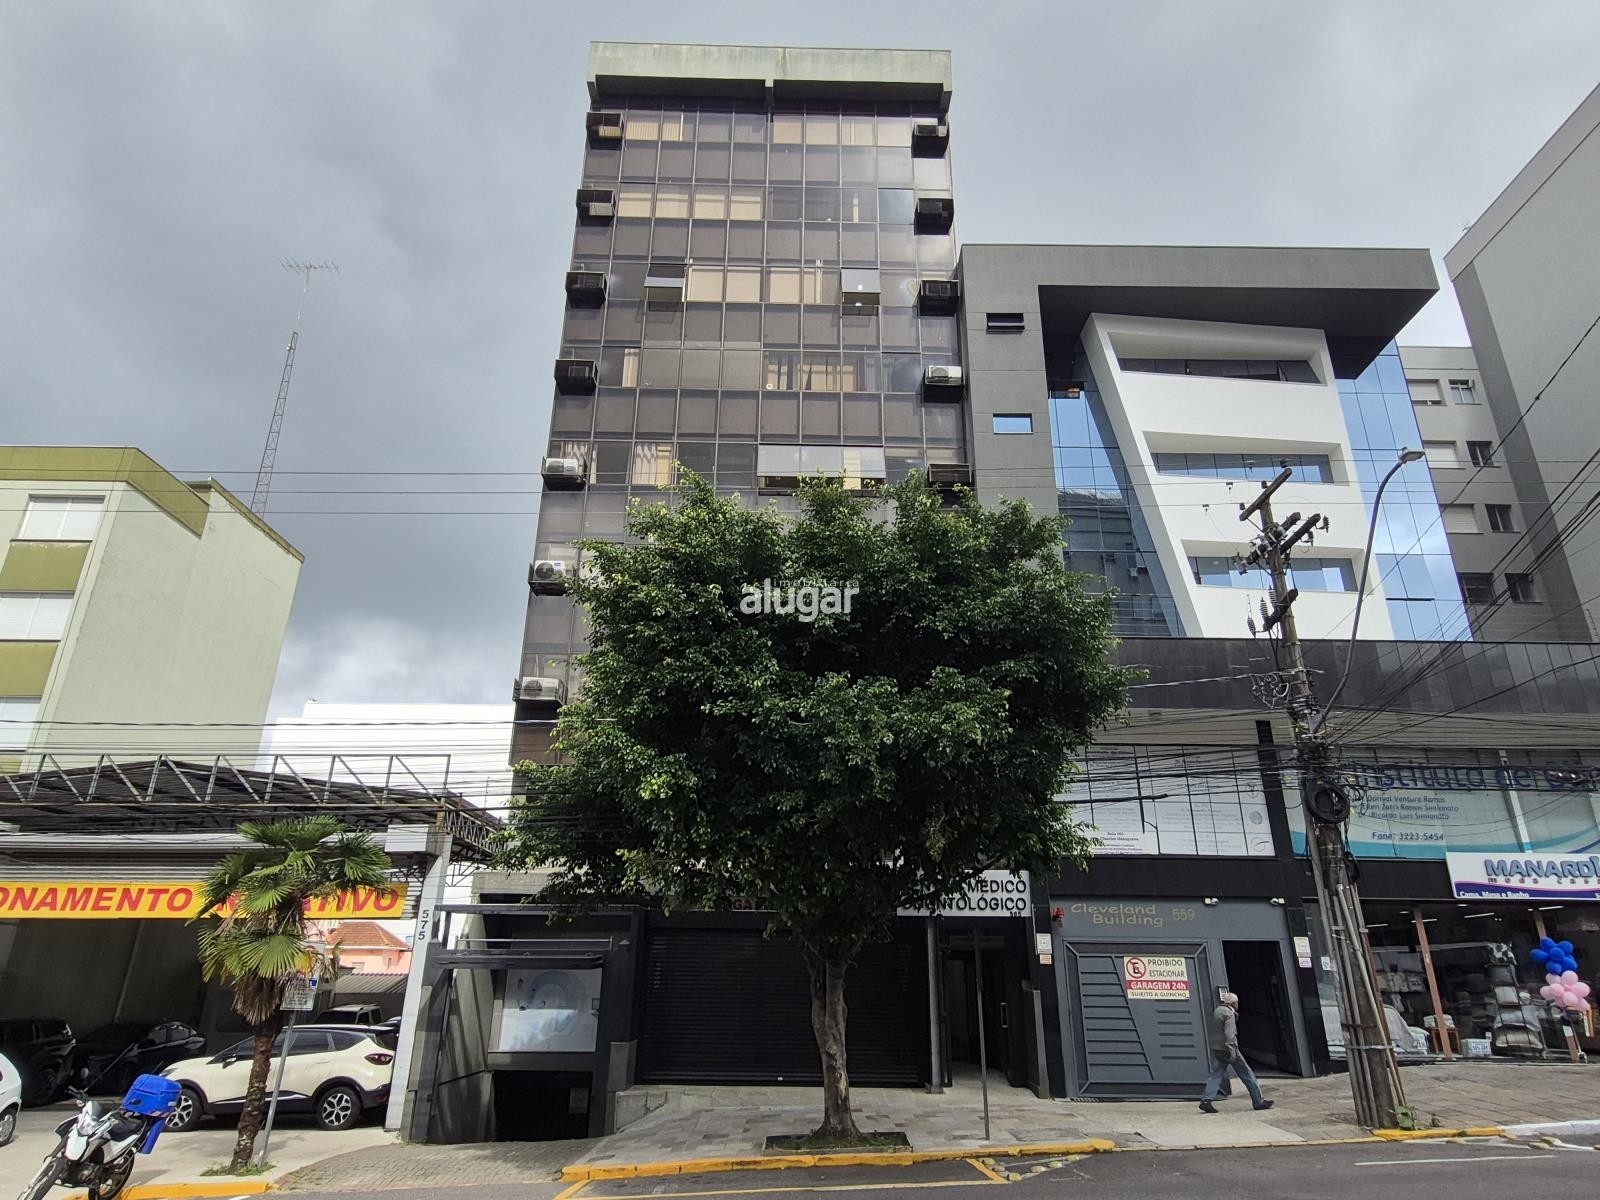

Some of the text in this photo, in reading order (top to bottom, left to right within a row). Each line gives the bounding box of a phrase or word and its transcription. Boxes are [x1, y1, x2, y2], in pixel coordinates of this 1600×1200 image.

[1495, 764, 1532, 788] de
[1071, 903, 1156, 915] Cleveland
[1172, 908, 1195, 921] 559
[418, 909, 430, 940] 575
[1092, 913, 1163, 928] Building
[1147, 958, 1183, 967] PROIBIDO
[1149, 970, 1185, 978] ESTACIONAR
[1131, 981, 1187, 990] GARAGEM 24h
